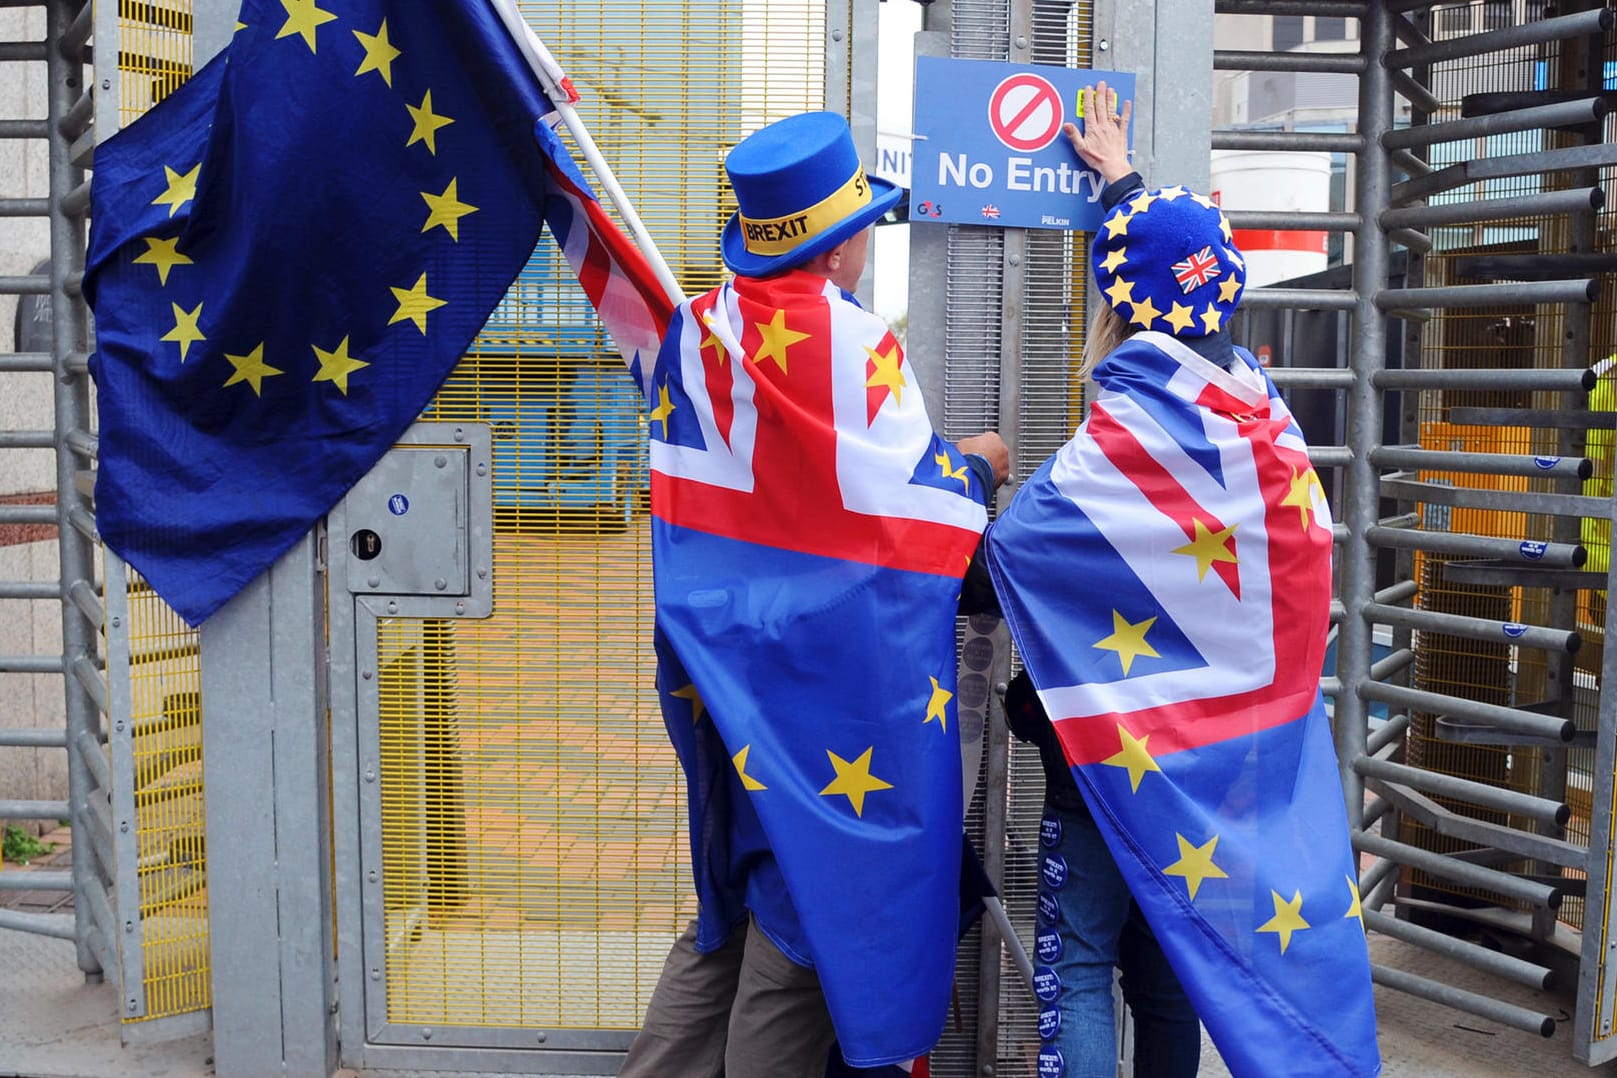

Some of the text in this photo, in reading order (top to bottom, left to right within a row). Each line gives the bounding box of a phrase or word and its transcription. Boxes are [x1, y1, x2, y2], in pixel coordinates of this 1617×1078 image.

[875, 148, 912, 174] NI
[938, 152, 1107, 203] No Entry
[745, 215, 808, 242] BREXIT
